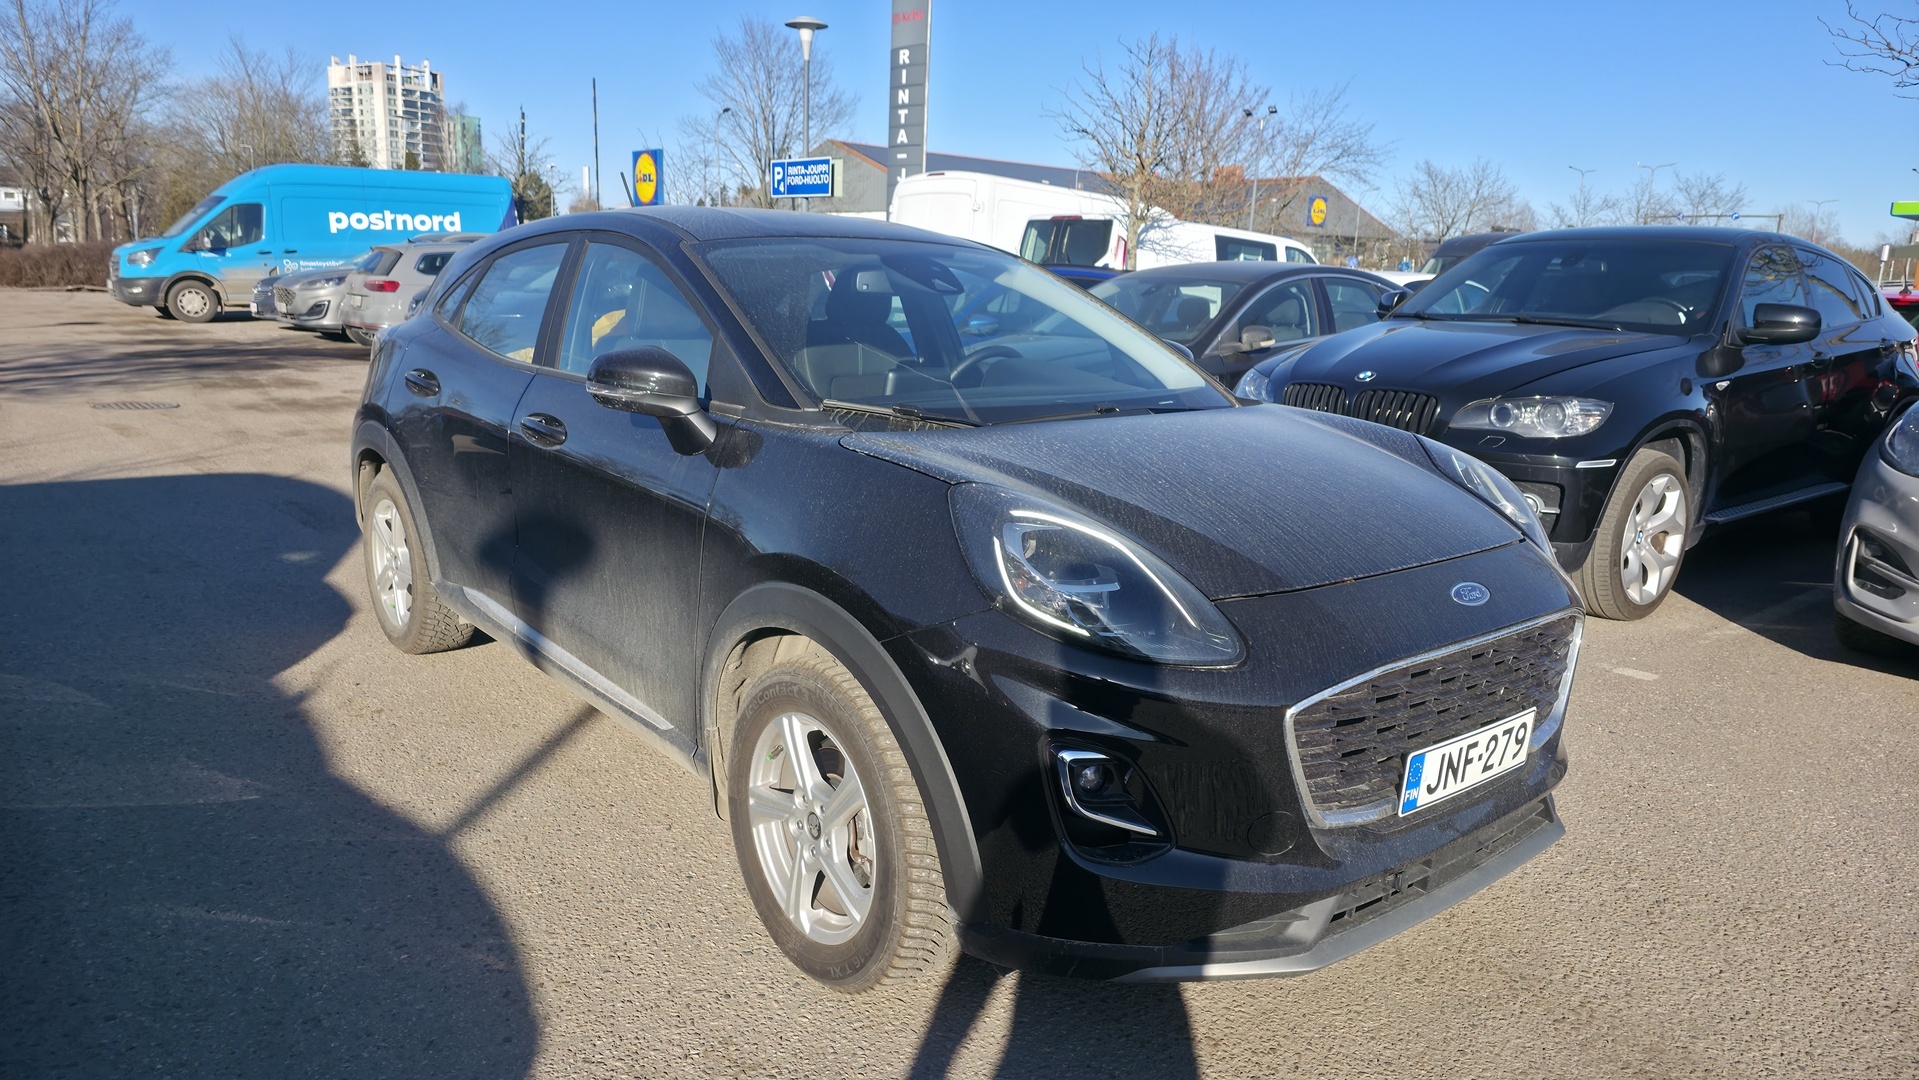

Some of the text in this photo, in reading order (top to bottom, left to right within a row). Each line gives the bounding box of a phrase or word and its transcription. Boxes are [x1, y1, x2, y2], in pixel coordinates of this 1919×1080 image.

[788, 163, 829, 176] RINTA-JOUPPI
[774, 166, 785, 193] P 4
[787, 173, 829, 186] FORD-HUOLTO
[328, 209, 462, 234] postnord
[1460, 586, 1482, 601] Ford
[1426, 721, 1529, 796] JNF-279
[1404, 786, 1420, 803] FIN
[827, 965, 843, 978] XL
